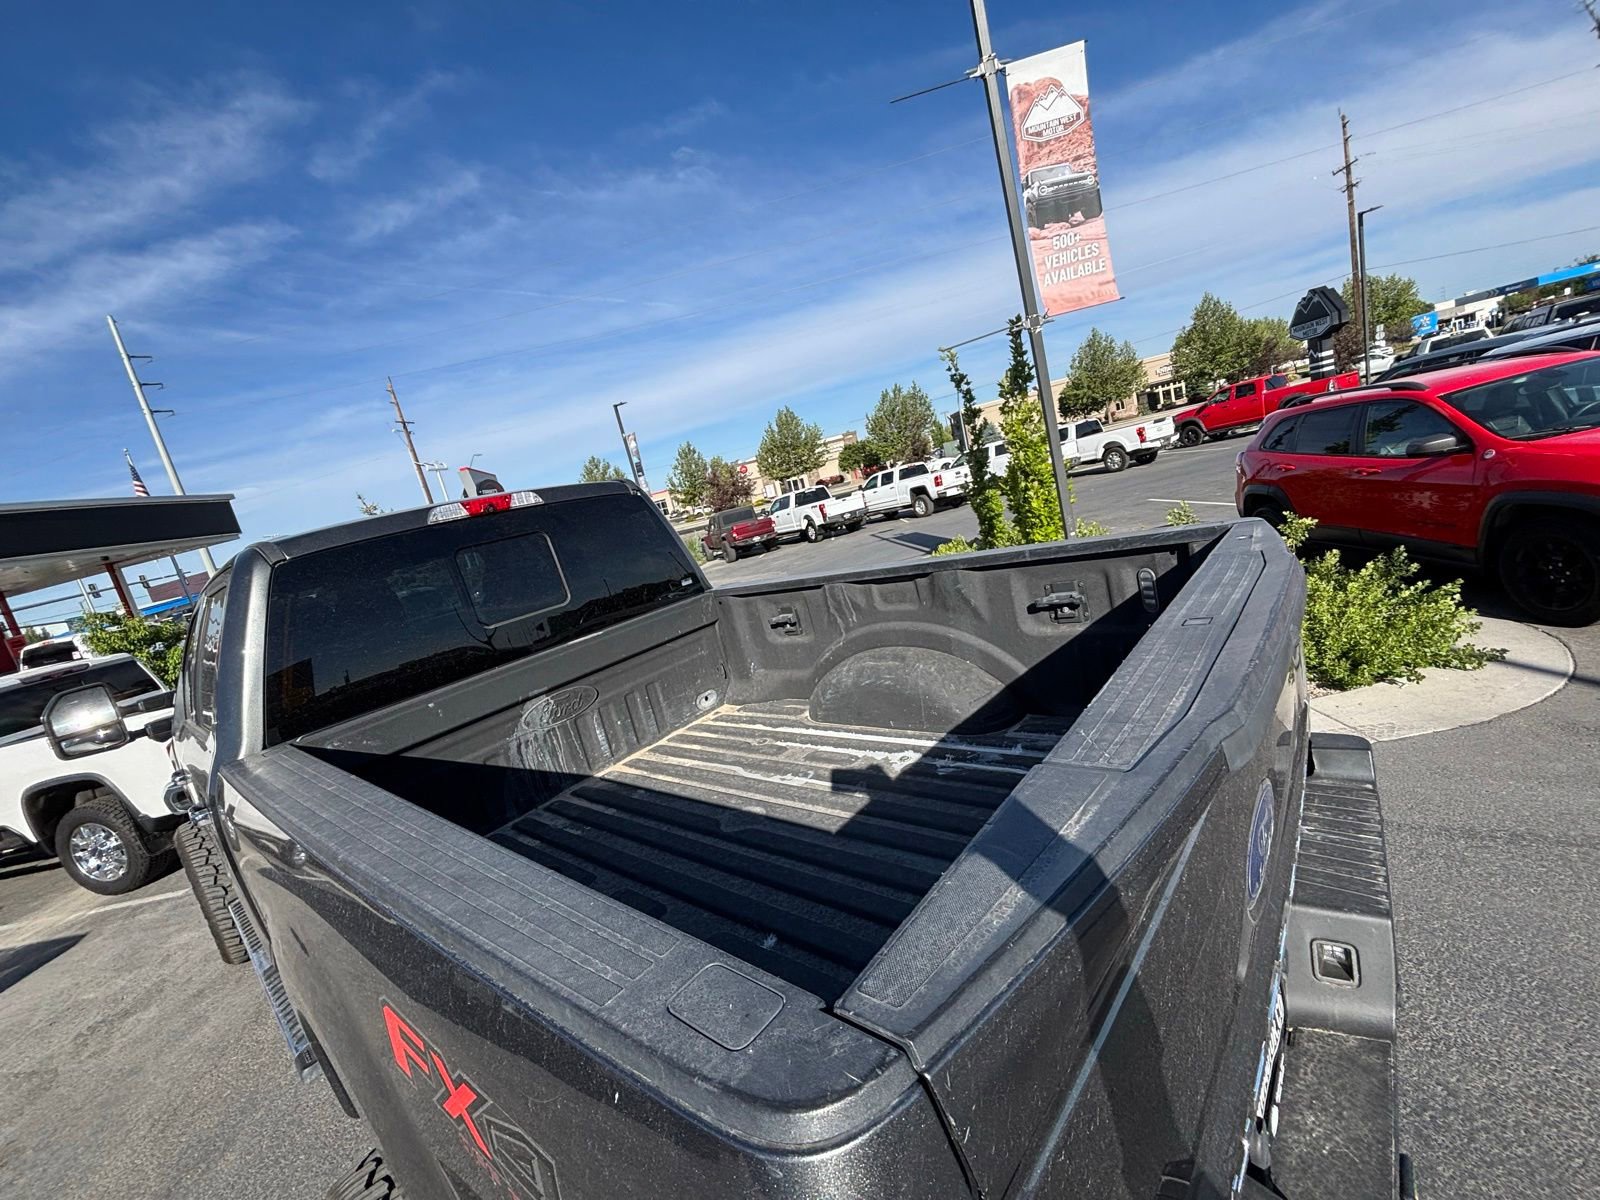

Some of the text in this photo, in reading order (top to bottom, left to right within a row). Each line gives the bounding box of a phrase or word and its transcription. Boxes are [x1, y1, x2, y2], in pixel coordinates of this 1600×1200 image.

[1060, 113, 1077, 126] WEST
[1042, 124, 1065, 137] MOTOR
[1052, 231, 1082, 250] 500+
[1044, 242, 1100, 271] VEHICLES
[1043, 257, 1107, 288] AVAILABLE
